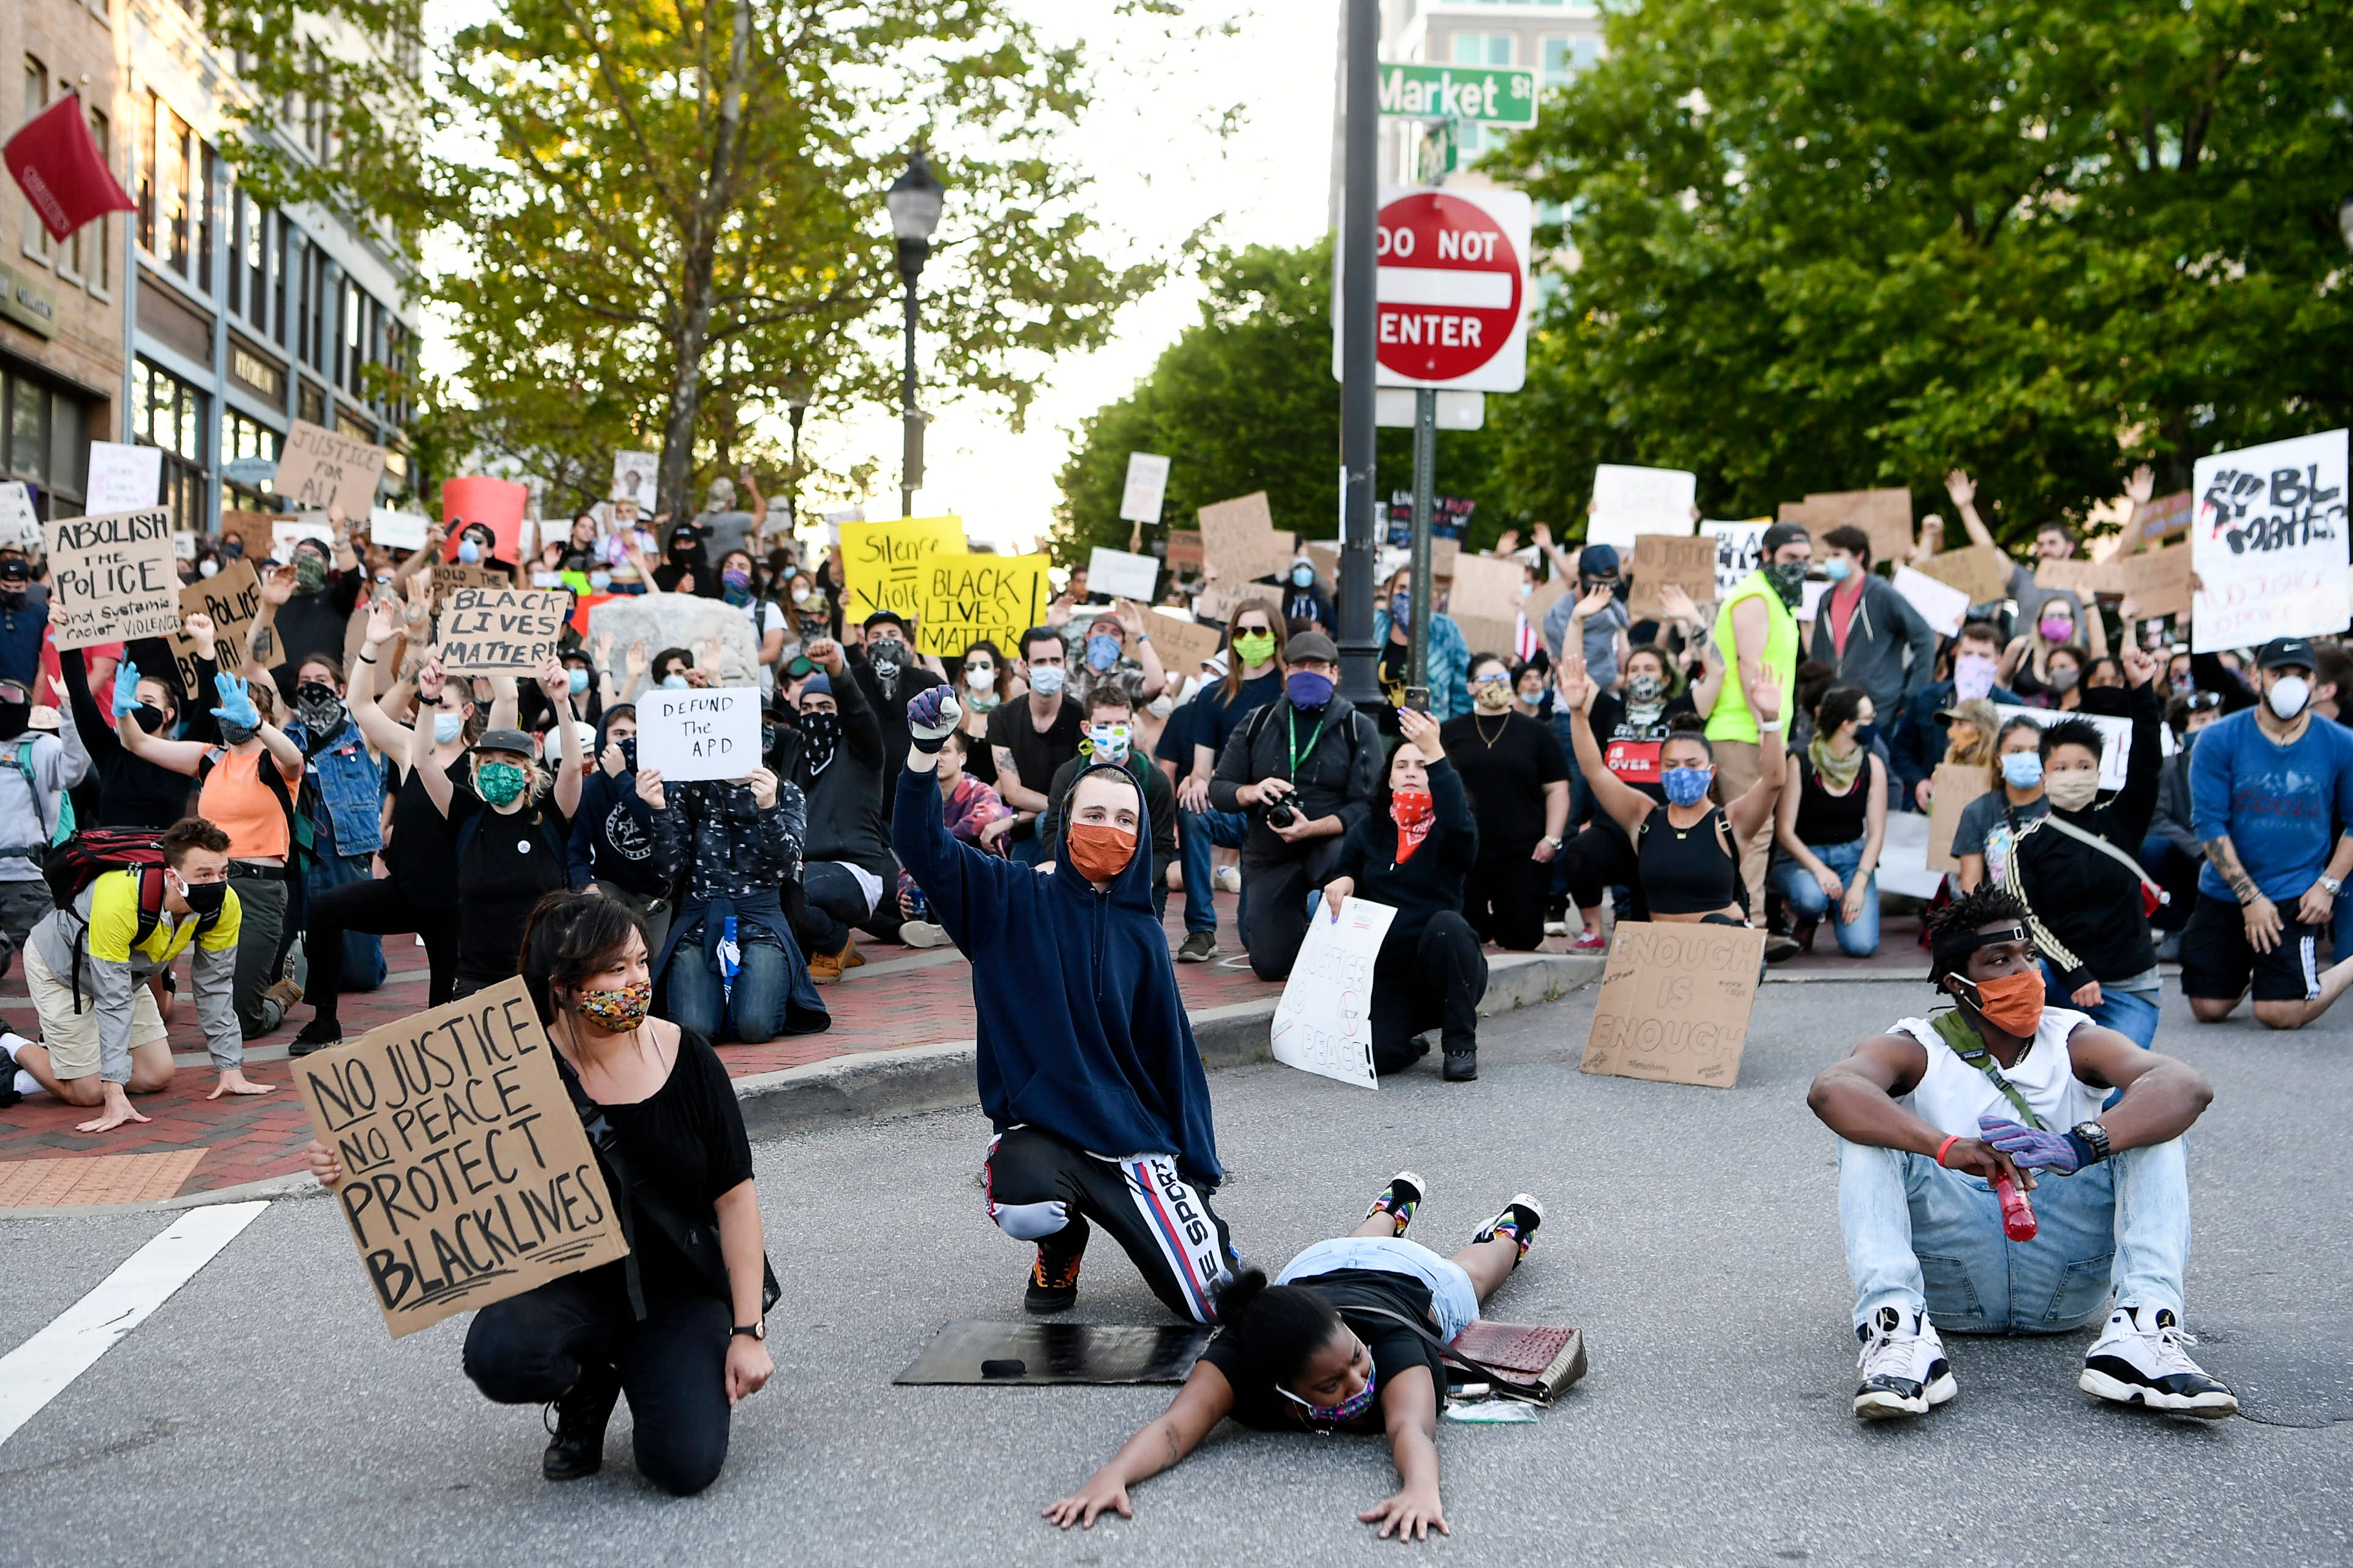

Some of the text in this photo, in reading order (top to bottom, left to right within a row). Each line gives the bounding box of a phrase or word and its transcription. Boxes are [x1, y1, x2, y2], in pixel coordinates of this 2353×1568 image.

[1378, 68, 1531, 117] Market St
[1438, 229, 1499, 262] NOT
[1380, 312, 1482, 348] ENTER
[293, 429, 381, 472] JUSTICE
[314, 460, 343, 482] FOR
[56, 513, 169, 552] ABOLISH
[84, 551, 128, 567] THE
[434, 568, 501, 586] HOLD THE
[932, 567, 1021, 605] BLACK
[453, 589, 563, 613] BLACK
[924, 596, 1009, 624] LIVES
[123, 614, 179, 637] VIOLENCE
[450, 612, 557, 636] LIVES
[439, 640, 555, 665] MATTER!
[663, 696, 734, 718] DEFUND
[681, 720, 713, 737] The
[693, 737, 733, 758] APD
[1608, 759, 1651, 771] OVER
[1610, 931, 1762, 973] ENOUGH
[1656, 975, 1693, 1010] IS
[1589, 1013, 1746, 1062] ENOUGH
[306, 996, 538, 1127] NO JUSTICE
[338, 1064, 533, 1175] NO PEACE
[340, 1112, 547, 1249] PROTECT
